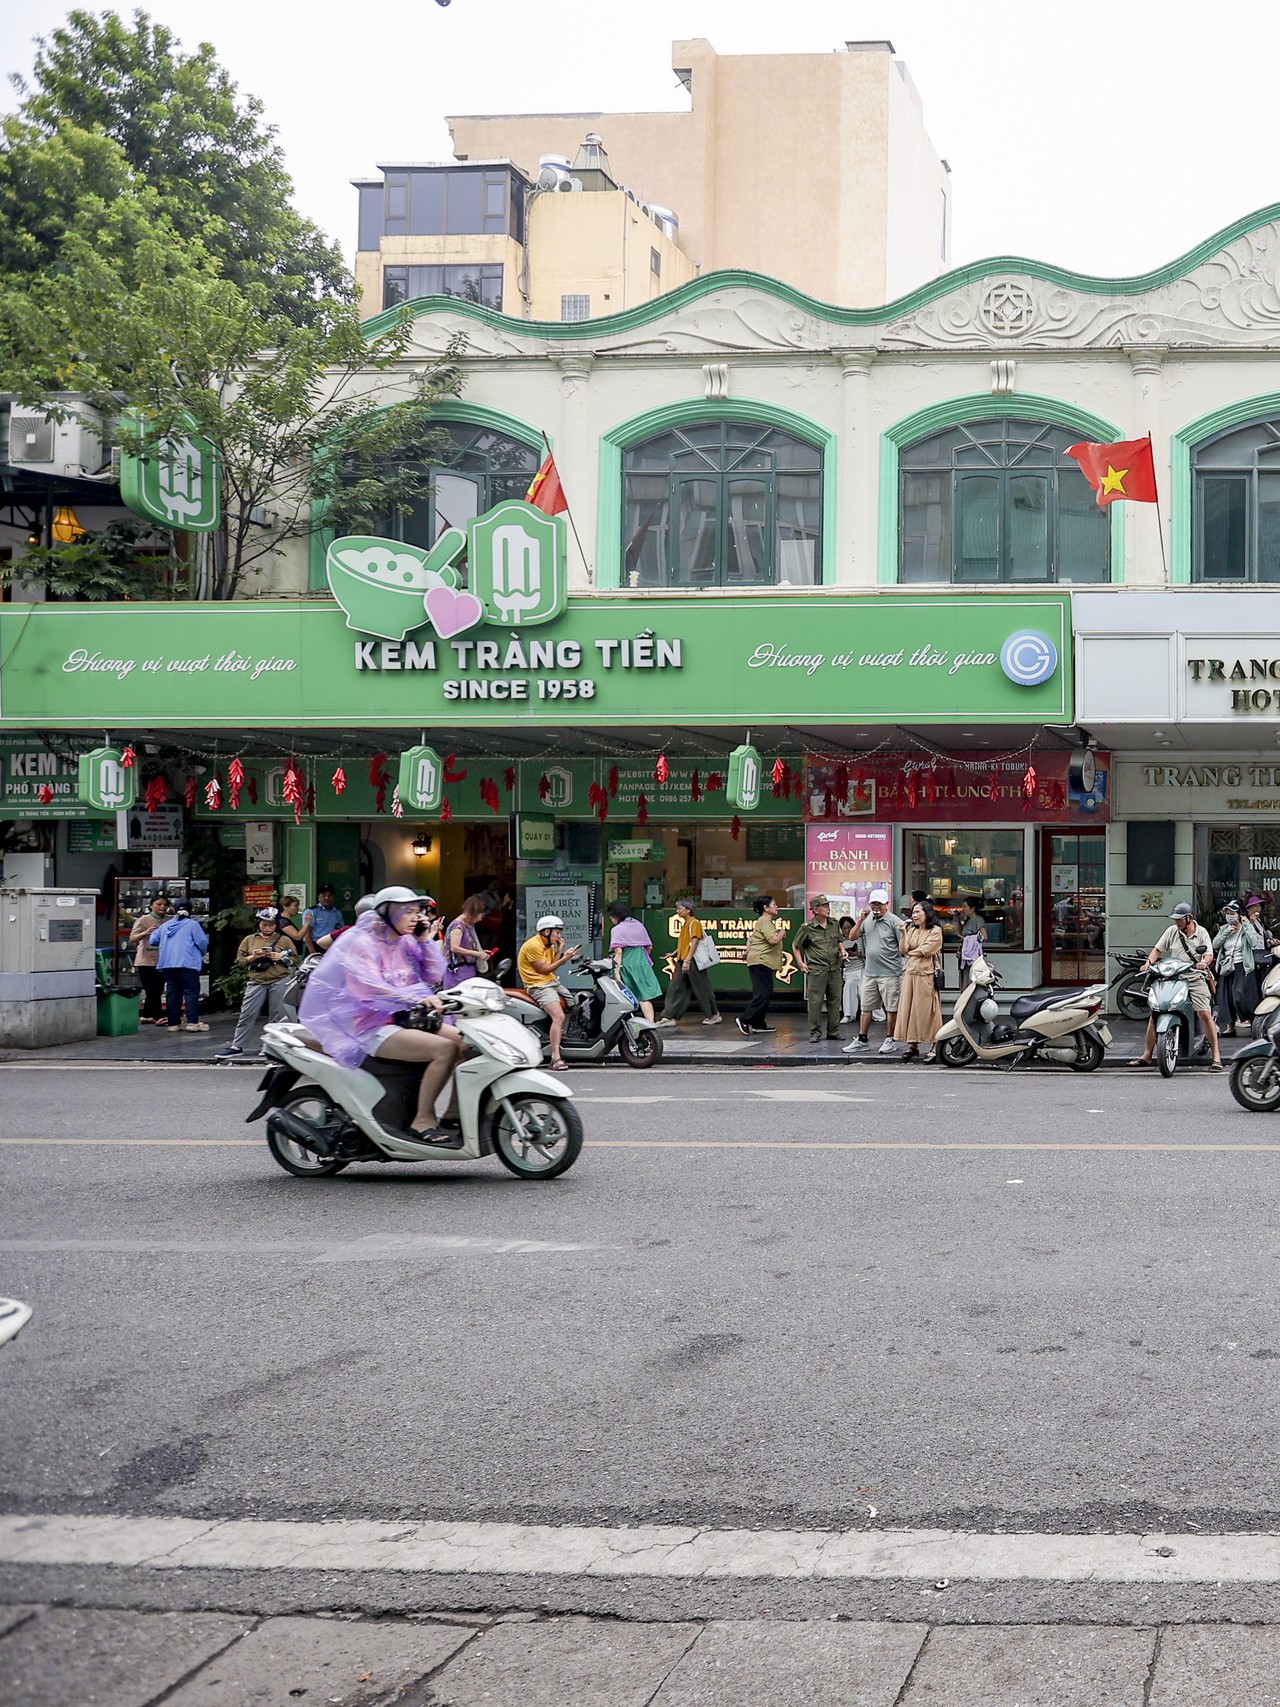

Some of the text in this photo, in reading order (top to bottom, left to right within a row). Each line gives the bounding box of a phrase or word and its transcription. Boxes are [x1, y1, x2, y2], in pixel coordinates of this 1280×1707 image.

[354, 628, 683, 670] KEM TRÀNG TIỀN
[141, 656, 163, 674] vị
[254, 656, 298, 680] gian
[831, 650, 854, 669] vị
[946, 649, 998, 675] gian
[443, 679, 596, 699] SINCE 1958
[11, 753, 57, 776] KEM
[1143, 766, 1243, 787] TRANG
[5, 780, 30, 795] PHỐ
[934, 786, 994, 798] TUNG
[996, 785, 1033, 798] TH
[830, 847, 869, 860] BÁNH
[809, 861, 889, 871] TRUNG THU
[1138, 892, 1164, 911] 35
[701, 919, 718, 930] EM
[717, 931, 745, 939] SINCE
